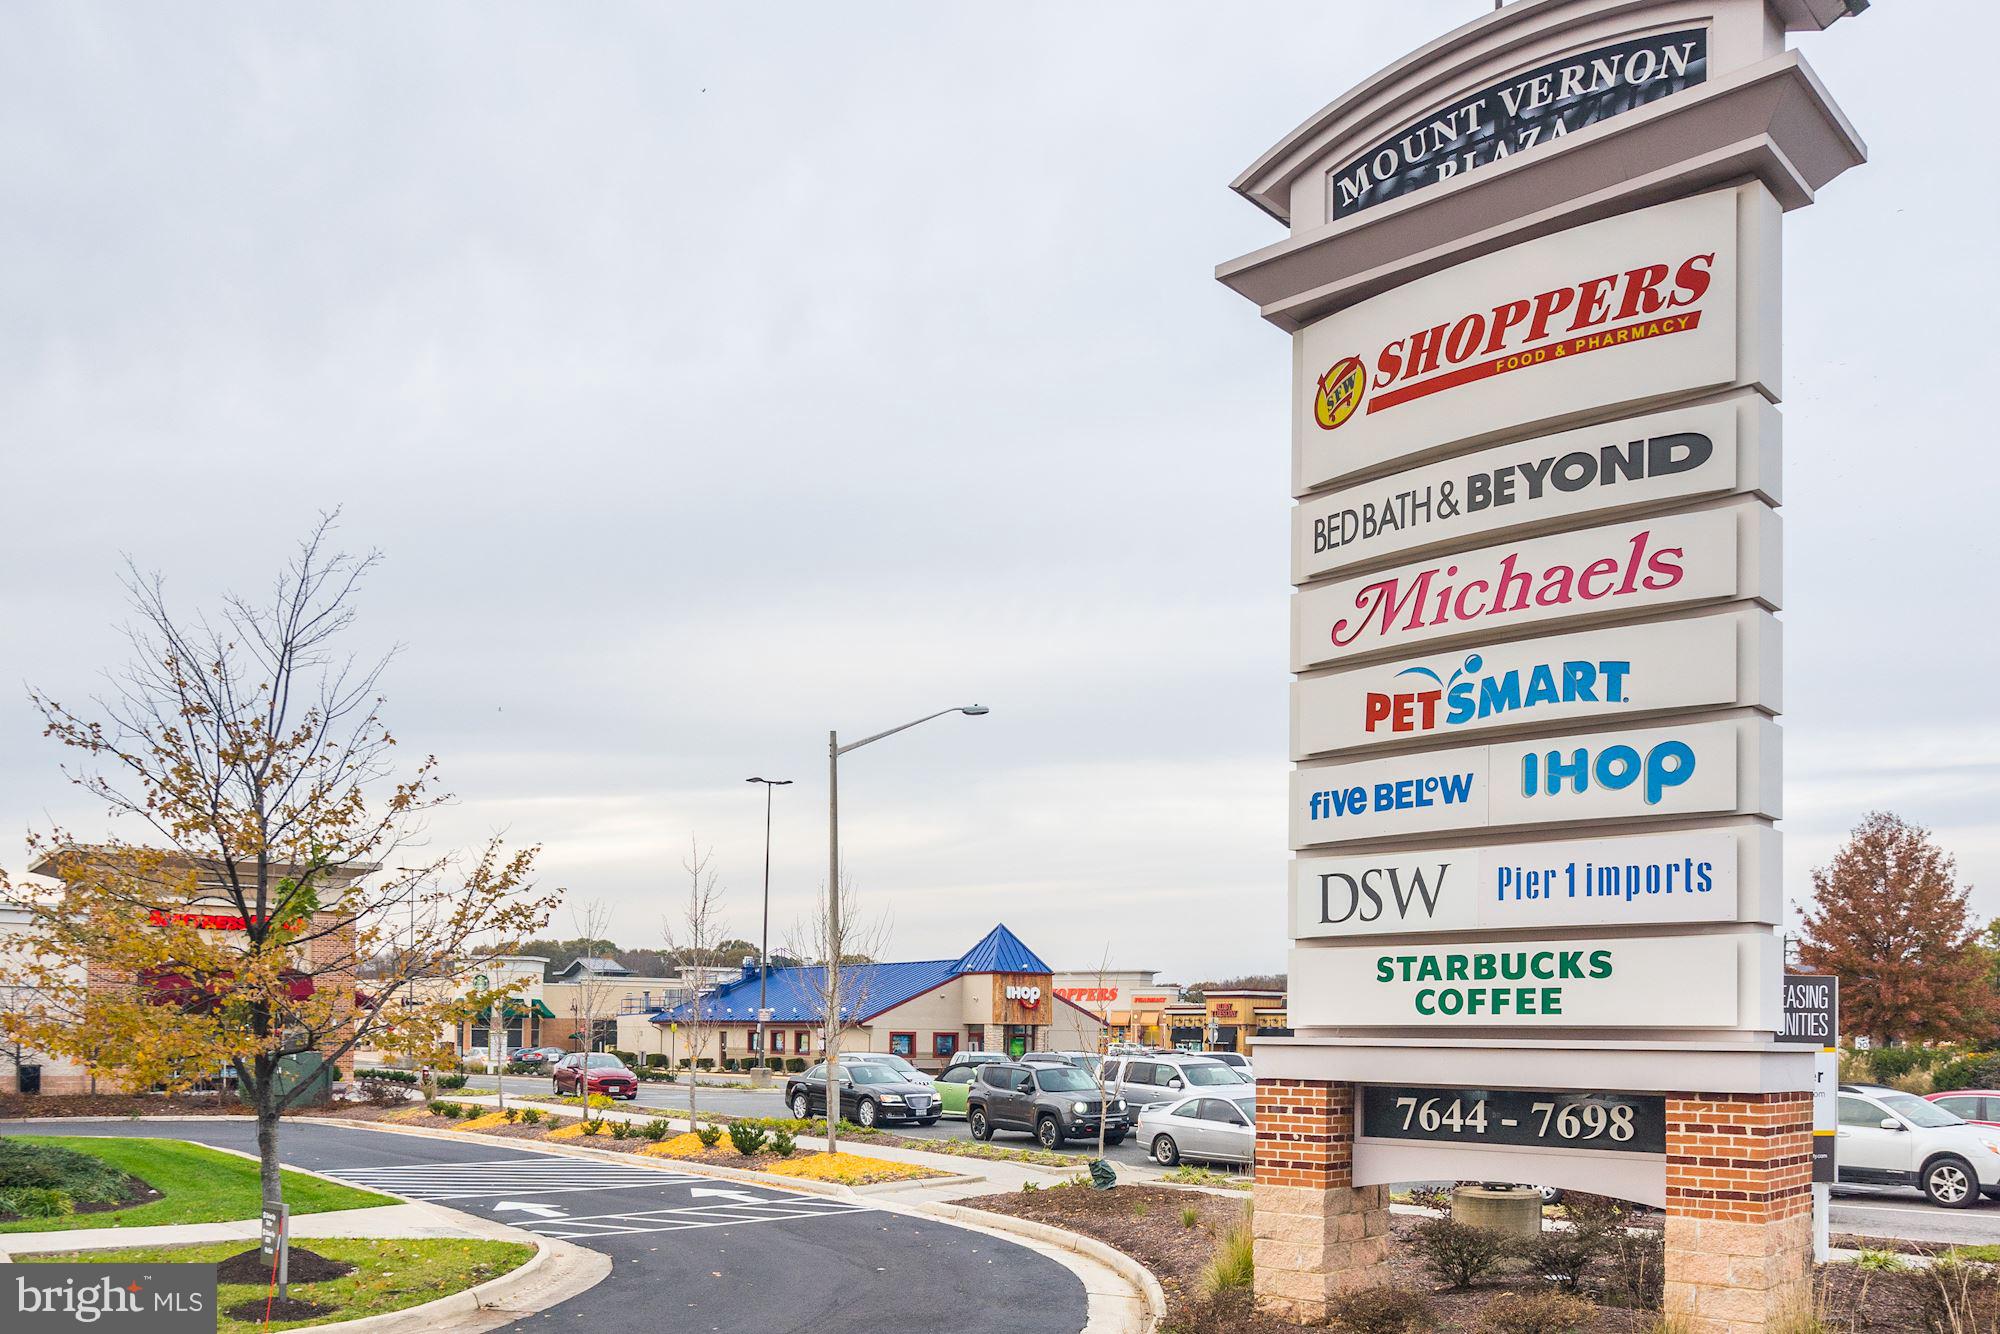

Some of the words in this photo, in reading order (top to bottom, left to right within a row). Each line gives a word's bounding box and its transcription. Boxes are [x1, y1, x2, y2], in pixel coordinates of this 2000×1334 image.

[1337, 99, 1487, 208] MOUNT
[1498, 42, 1697, 119] VERNON
[1372, 252, 1716, 391] SHOPPERS
[1495, 349, 1547, 374] FOOD
[1555, 345, 1566, 358] &
[1575, 316, 1690, 352] PHARMACY
[1327, 373, 1357, 413] SFW
[1314, 509, 1359, 554] BED
[1363, 485, 1431, 540] BATH
[1437, 480, 1461, 519] &
[1467, 432, 1714, 512] BEYOND
[1331, 530, 1684, 647] Michaels
[1310, 786, 1367, 821] five
[1317, 863, 1452, 924] DSW
[1498, 866, 1563, 901] Pier
[1565, 862, 1576, 898] 1
[1586, 857, 1713, 902] imports
[1376, 950, 1614, 984] STARBUCKS
[1053, 987, 1119, 1002] OPPERS
[1415, 987, 1563, 1016] COFFEE
[1396, 1096, 1488, 1134] 7644
[1502, 1118, 1518, 1127] -
[1531, 1102, 1635, 1142] 7698
